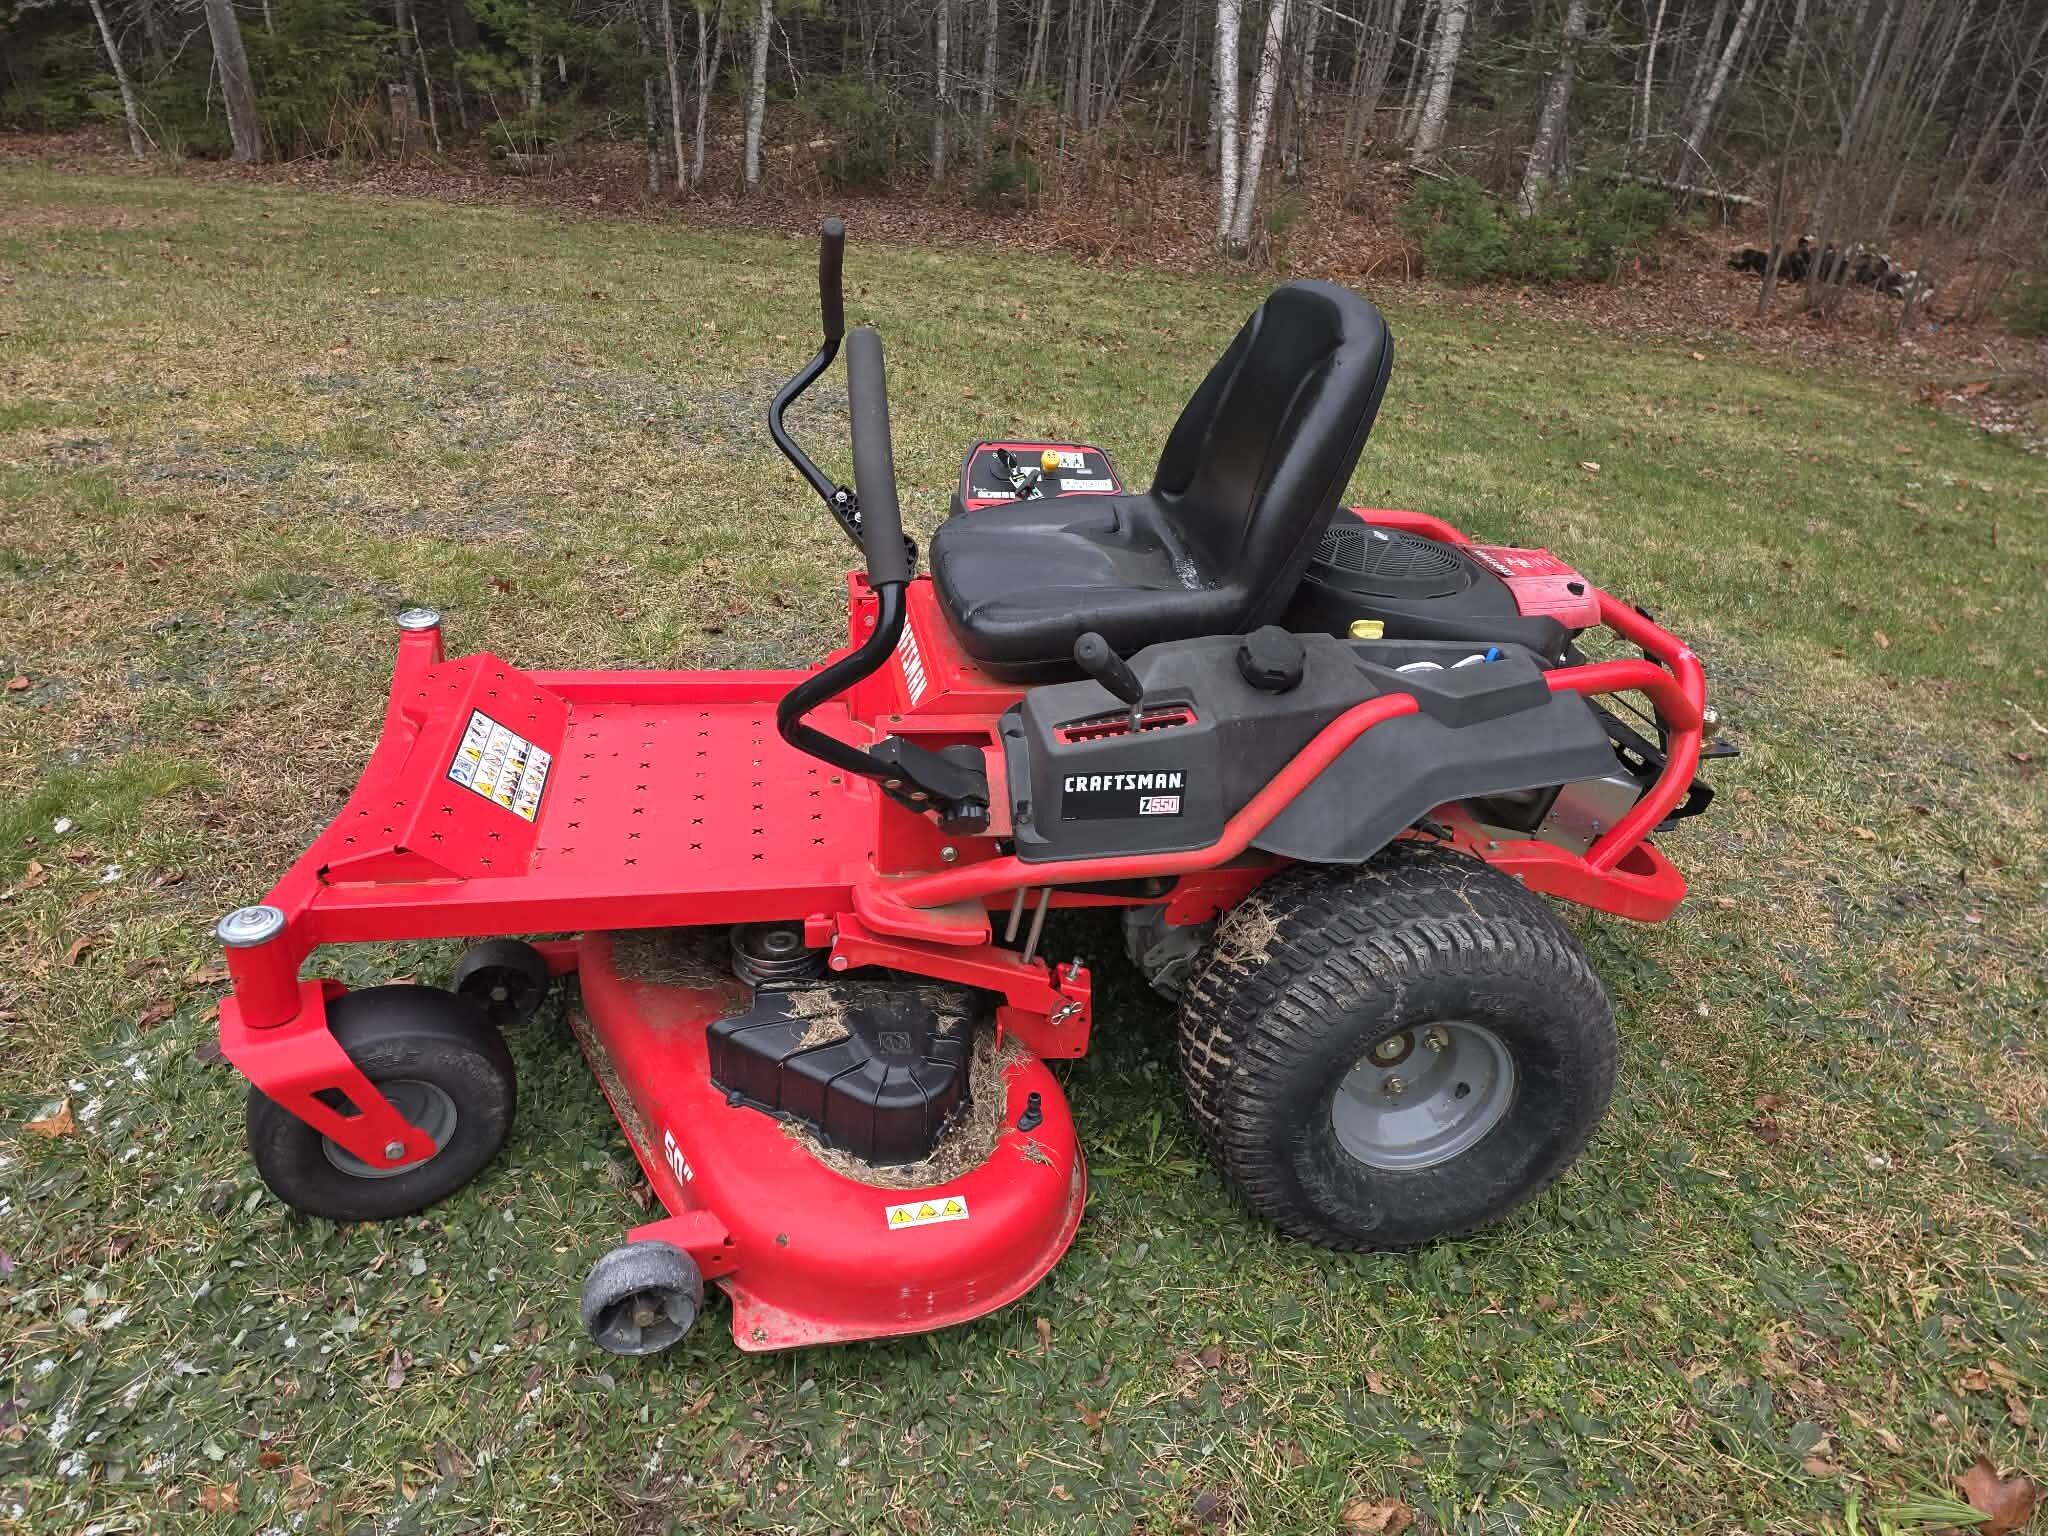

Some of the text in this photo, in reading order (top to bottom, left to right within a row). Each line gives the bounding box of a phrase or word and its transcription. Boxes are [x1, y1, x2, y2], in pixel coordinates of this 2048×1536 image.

[897, 613, 928, 707] AFTSMAN
[1064, 772, 1182, 793] CRAFTSMAN
[1140, 796, 1180, 814] Z550
